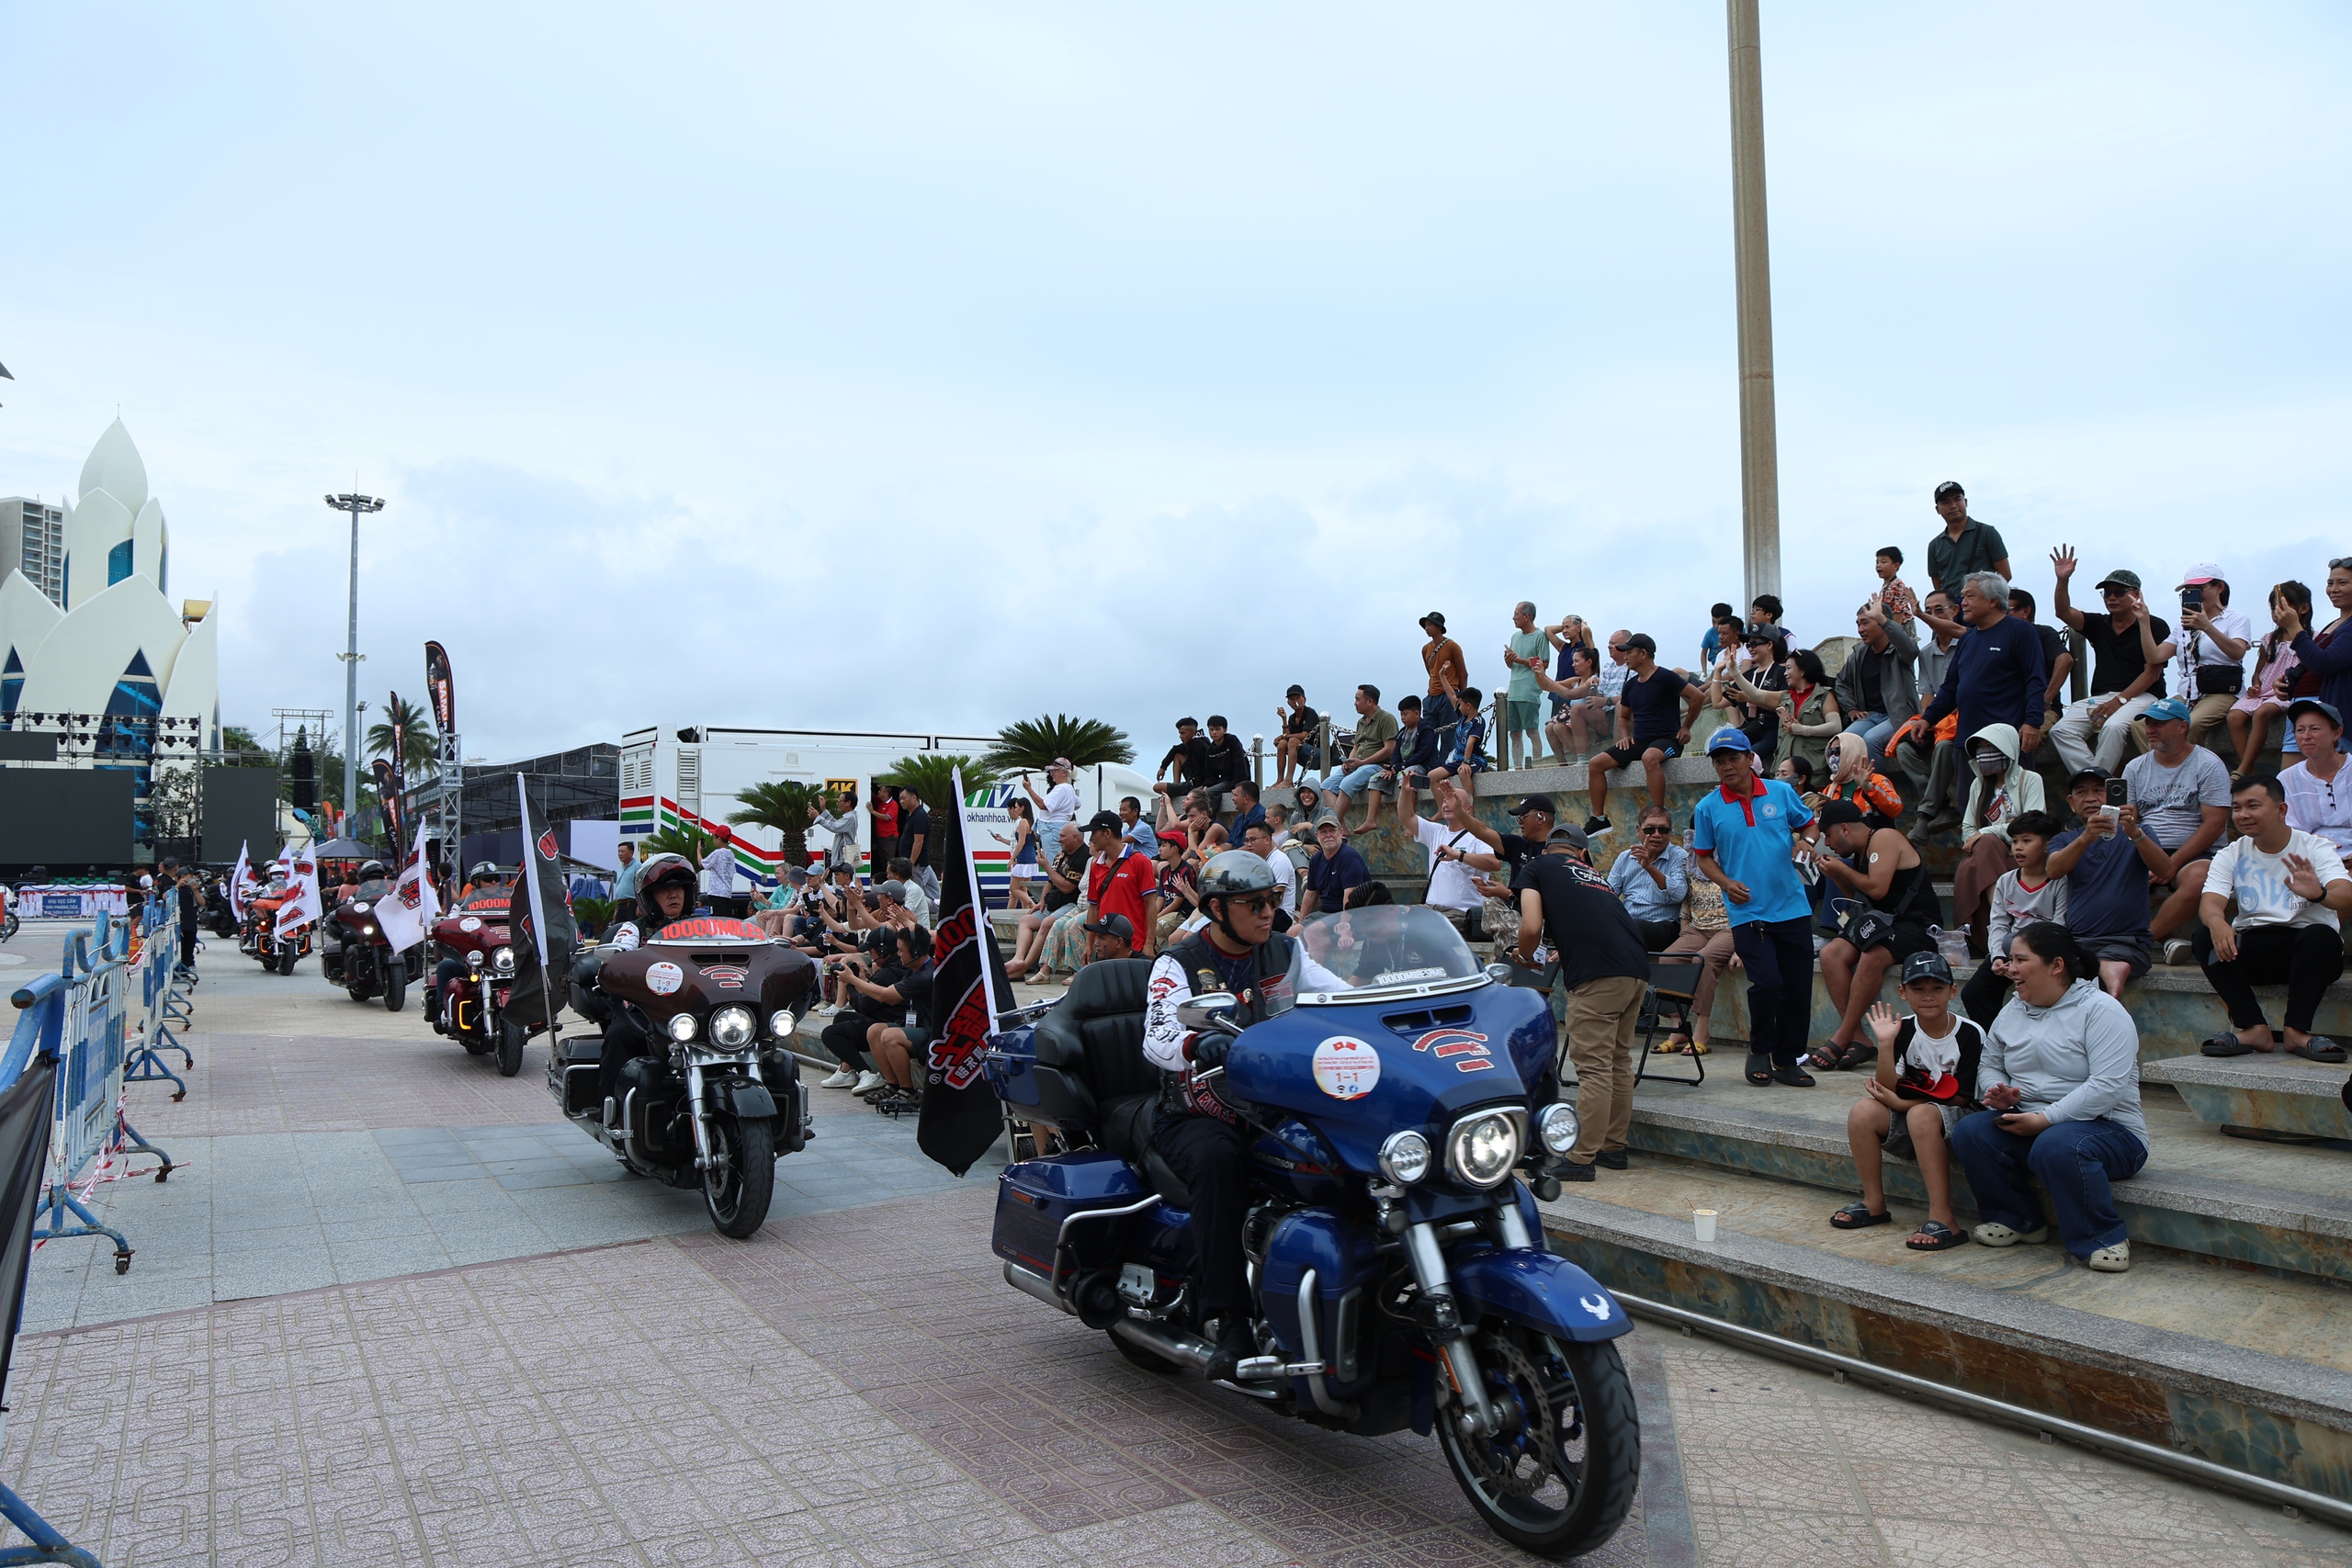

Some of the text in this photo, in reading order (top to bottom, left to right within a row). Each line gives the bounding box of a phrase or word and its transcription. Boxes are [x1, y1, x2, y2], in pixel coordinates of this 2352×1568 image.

[468, 898, 511, 911] 10000M
[661, 919, 765, 941] 10000MILES
[1196, 1090, 1237, 1124] RIDER
